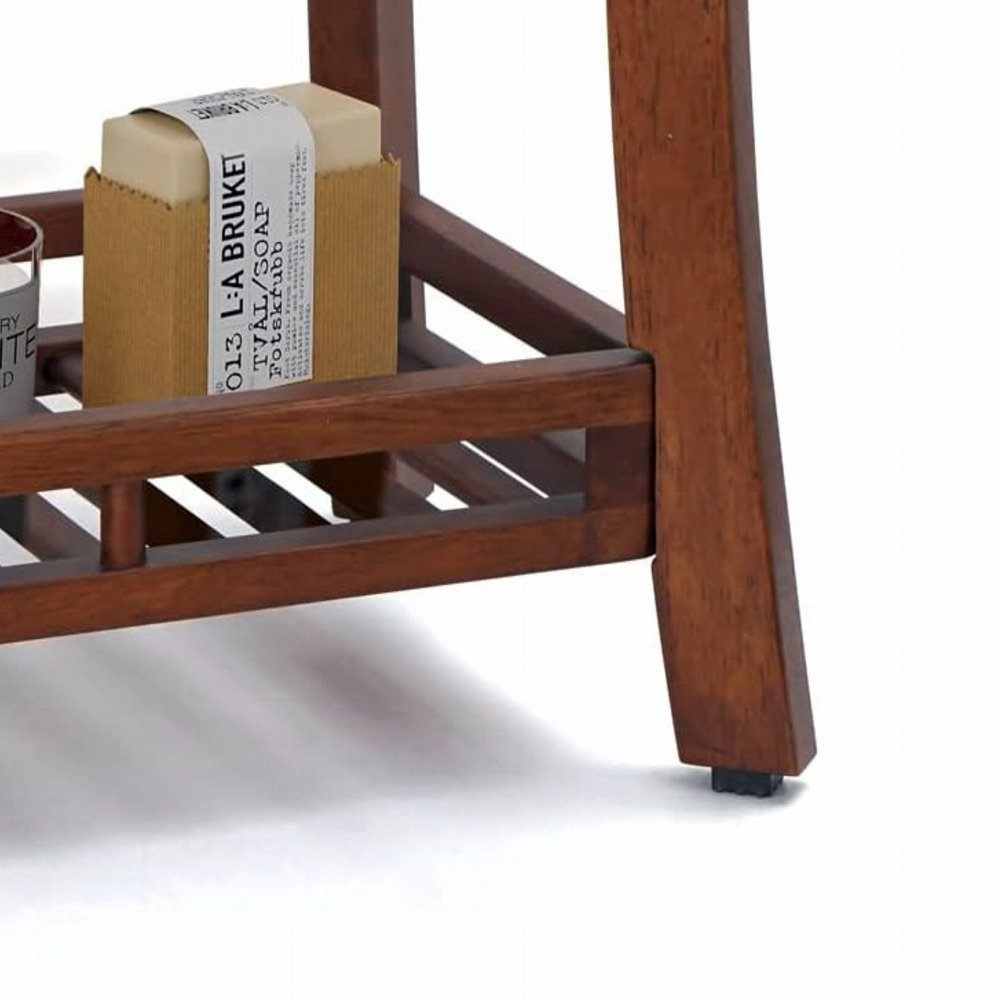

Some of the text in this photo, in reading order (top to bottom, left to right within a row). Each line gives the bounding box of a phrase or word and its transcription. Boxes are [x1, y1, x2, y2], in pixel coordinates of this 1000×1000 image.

[220, 153, 246, 391] 013 L:A BRUKET
